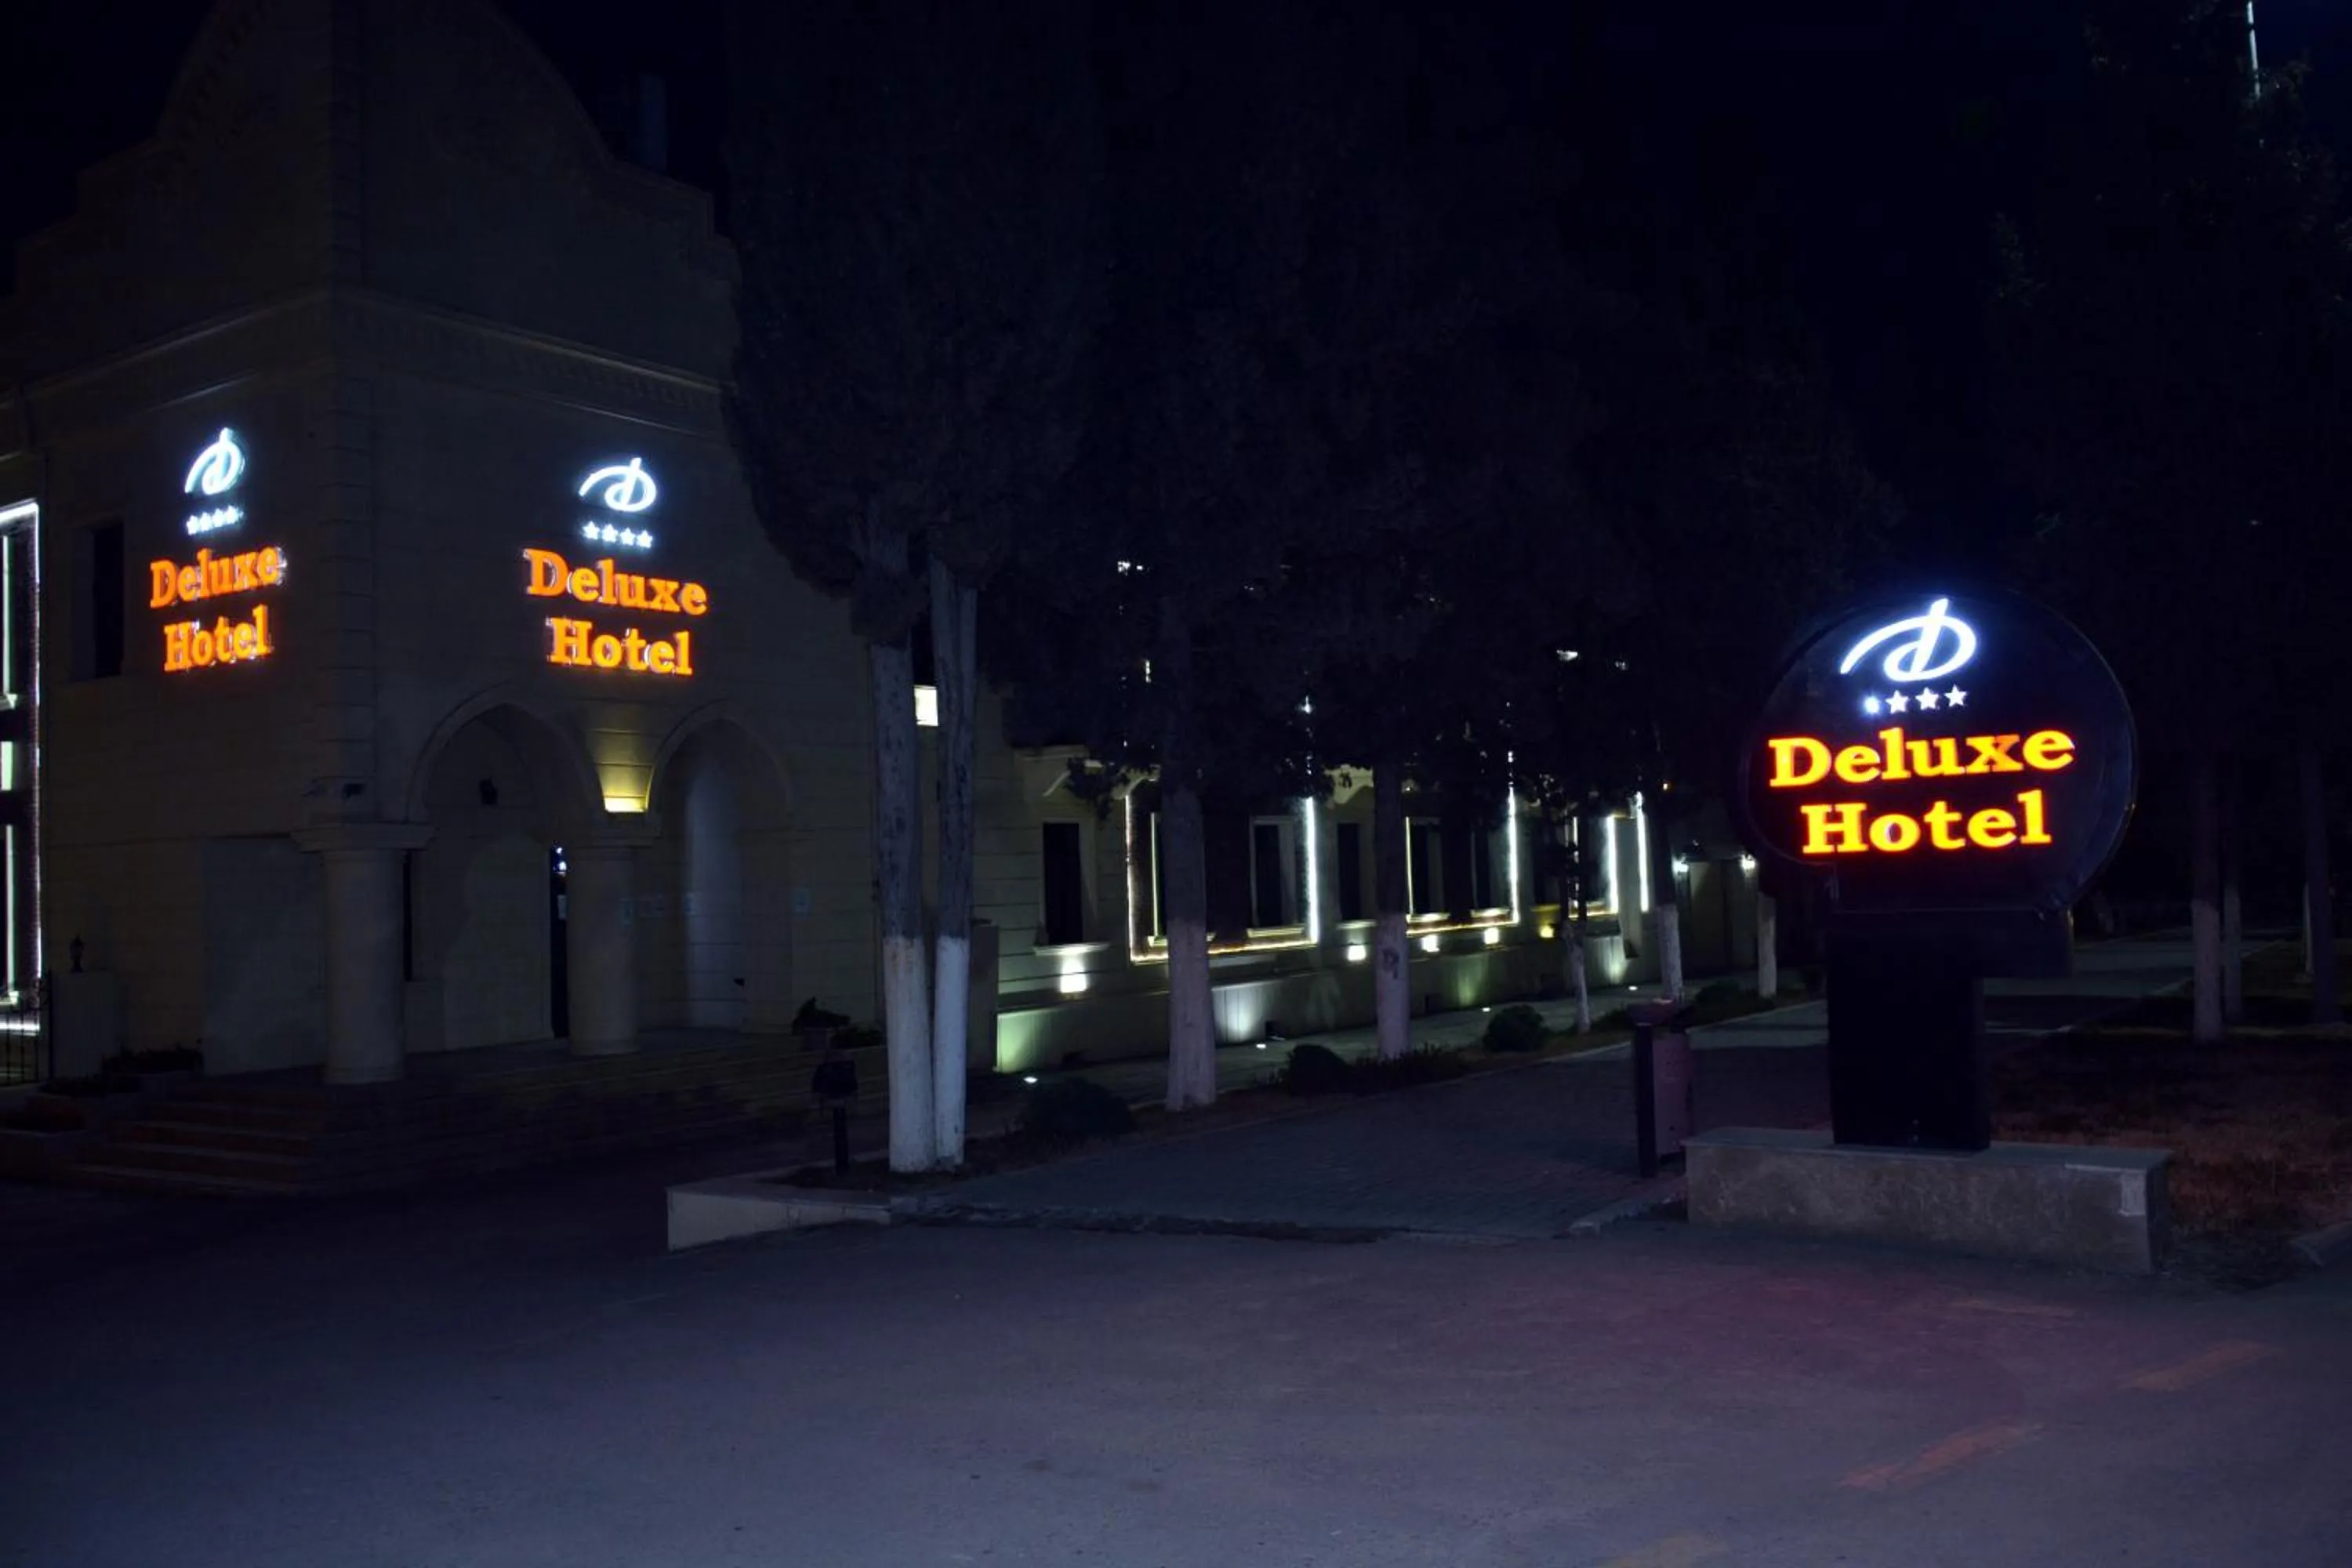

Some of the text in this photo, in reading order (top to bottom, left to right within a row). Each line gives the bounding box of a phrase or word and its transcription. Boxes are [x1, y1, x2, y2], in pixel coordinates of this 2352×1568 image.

[149, 546, 288, 609] Deluxe
[522, 547, 708, 615] Deluxe
[163, 604, 274, 673] Hotel
[544, 616, 694, 676] Hotel
[1767, 726, 2075, 788] Deluxe
[1800, 789, 2053, 855] Hotel
